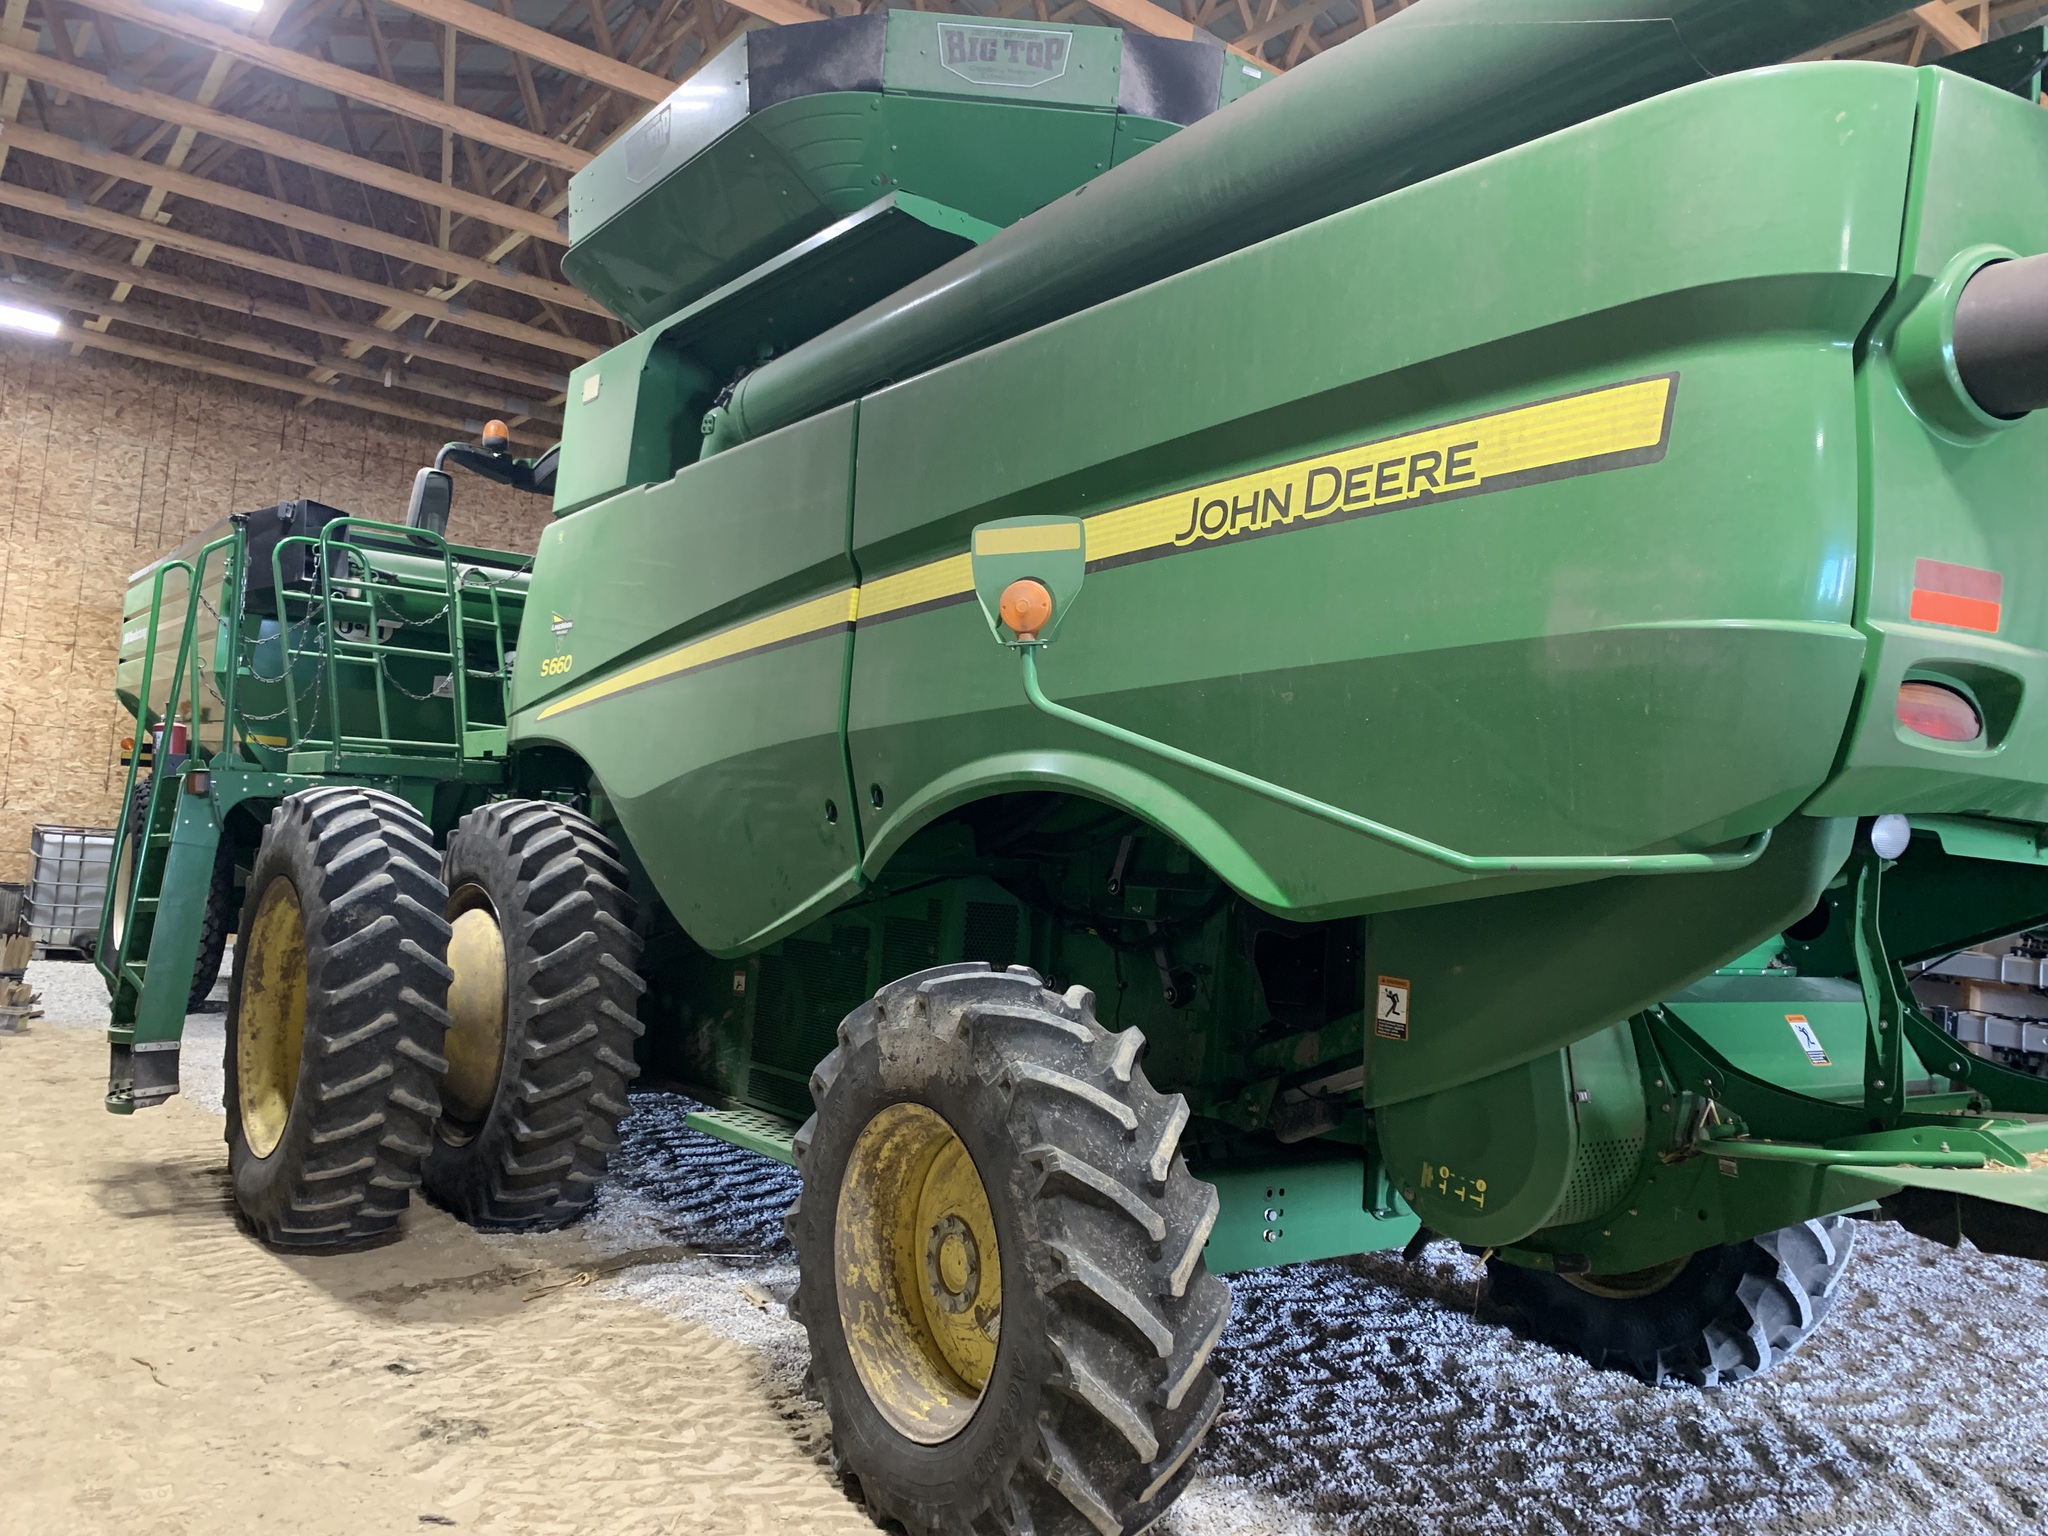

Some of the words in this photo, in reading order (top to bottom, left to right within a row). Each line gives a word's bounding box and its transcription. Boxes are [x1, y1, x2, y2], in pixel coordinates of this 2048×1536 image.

[945, 30, 997, 64] BIG
[1004, 37, 1065, 71] TOP
[1174, 482, 1293, 542] JOHN
[1303, 440, 1479, 515] DEERE
[540, 654, 573, 677] S660
